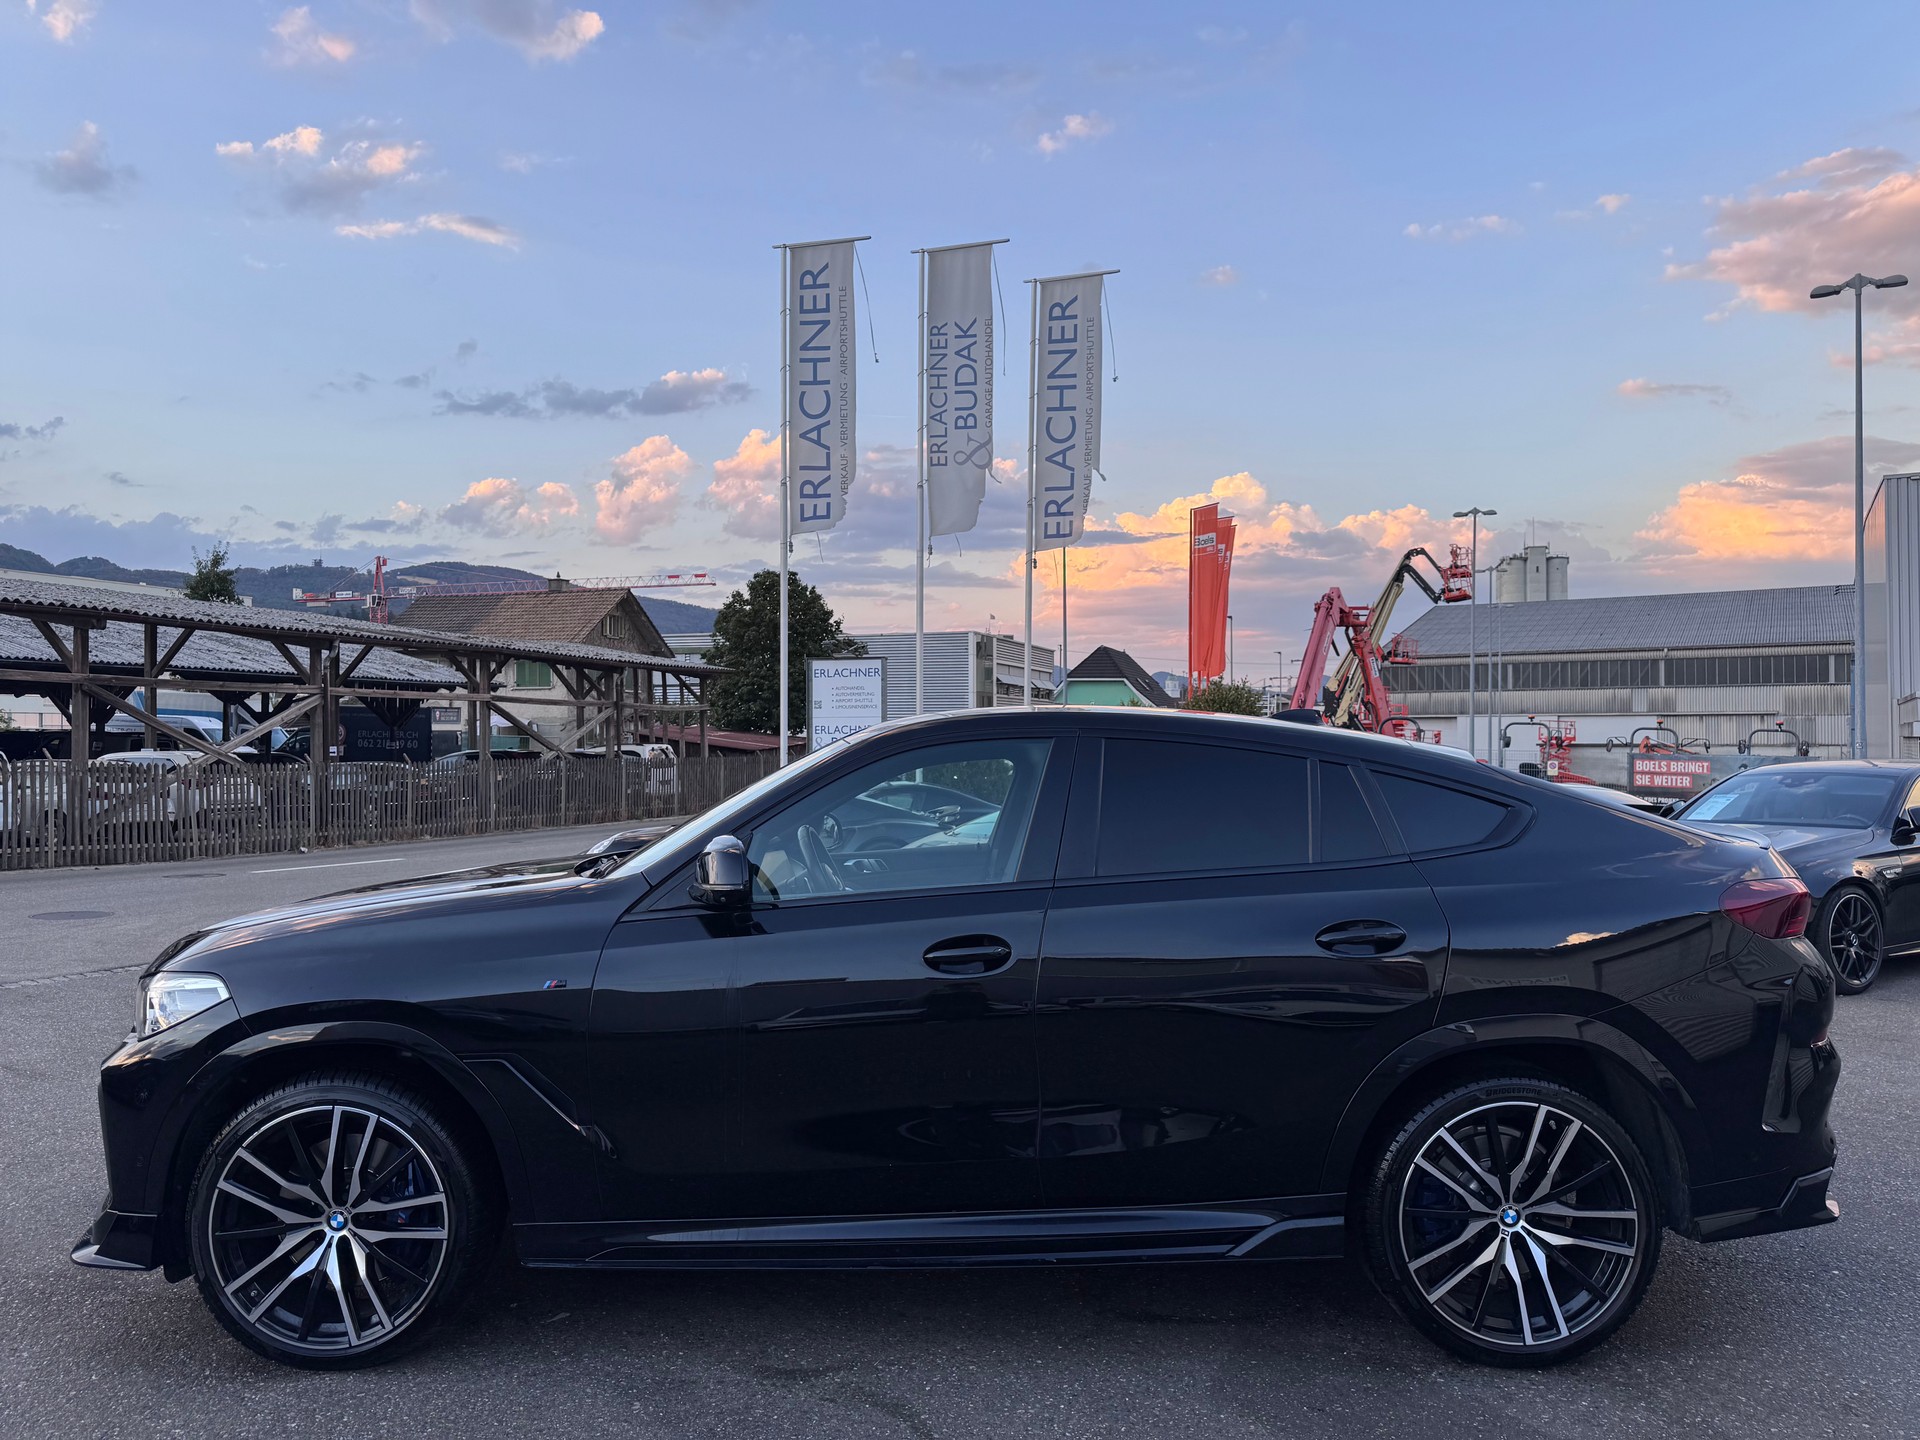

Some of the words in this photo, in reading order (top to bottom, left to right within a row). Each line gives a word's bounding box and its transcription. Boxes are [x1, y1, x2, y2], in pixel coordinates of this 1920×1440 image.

[839, 285, 847, 377] AIRPORTSHUTTLE
[985, 316, 993, 386] AUTOHANDEL
[954, 316, 978, 430] BUDAK
[1086, 316, 1095, 401] AIRPORTSHUTTLE
[799, 262, 831, 522] ERLACHNER
[840, 382, 849, 448] VERMIETUNG
[930, 321, 948, 467] ERLACHNER
[985, 388, 993, 428] GARAGE
[1043, 295, 1078, 539] ERLACHNER
[953, 431, 992, 470] &
[1084, 408, 1093, 468] VERMIETUNG
[840, 454, 849, 497] VERKAUF
[814, 668, 880, 678] ERLACHNER
[358, 730, 418, 739] ERLACHER.CH
[406, 739, 418, 749] 60
[814, 725, 872, 735] ERLACH
[1636, 761, 1667, 772] BOELS
[1670, 761, 1708, 773] BRINGT
[1636, 774, 1651, 785] SIE
[1654, 775, 1690, 786] WEITER
